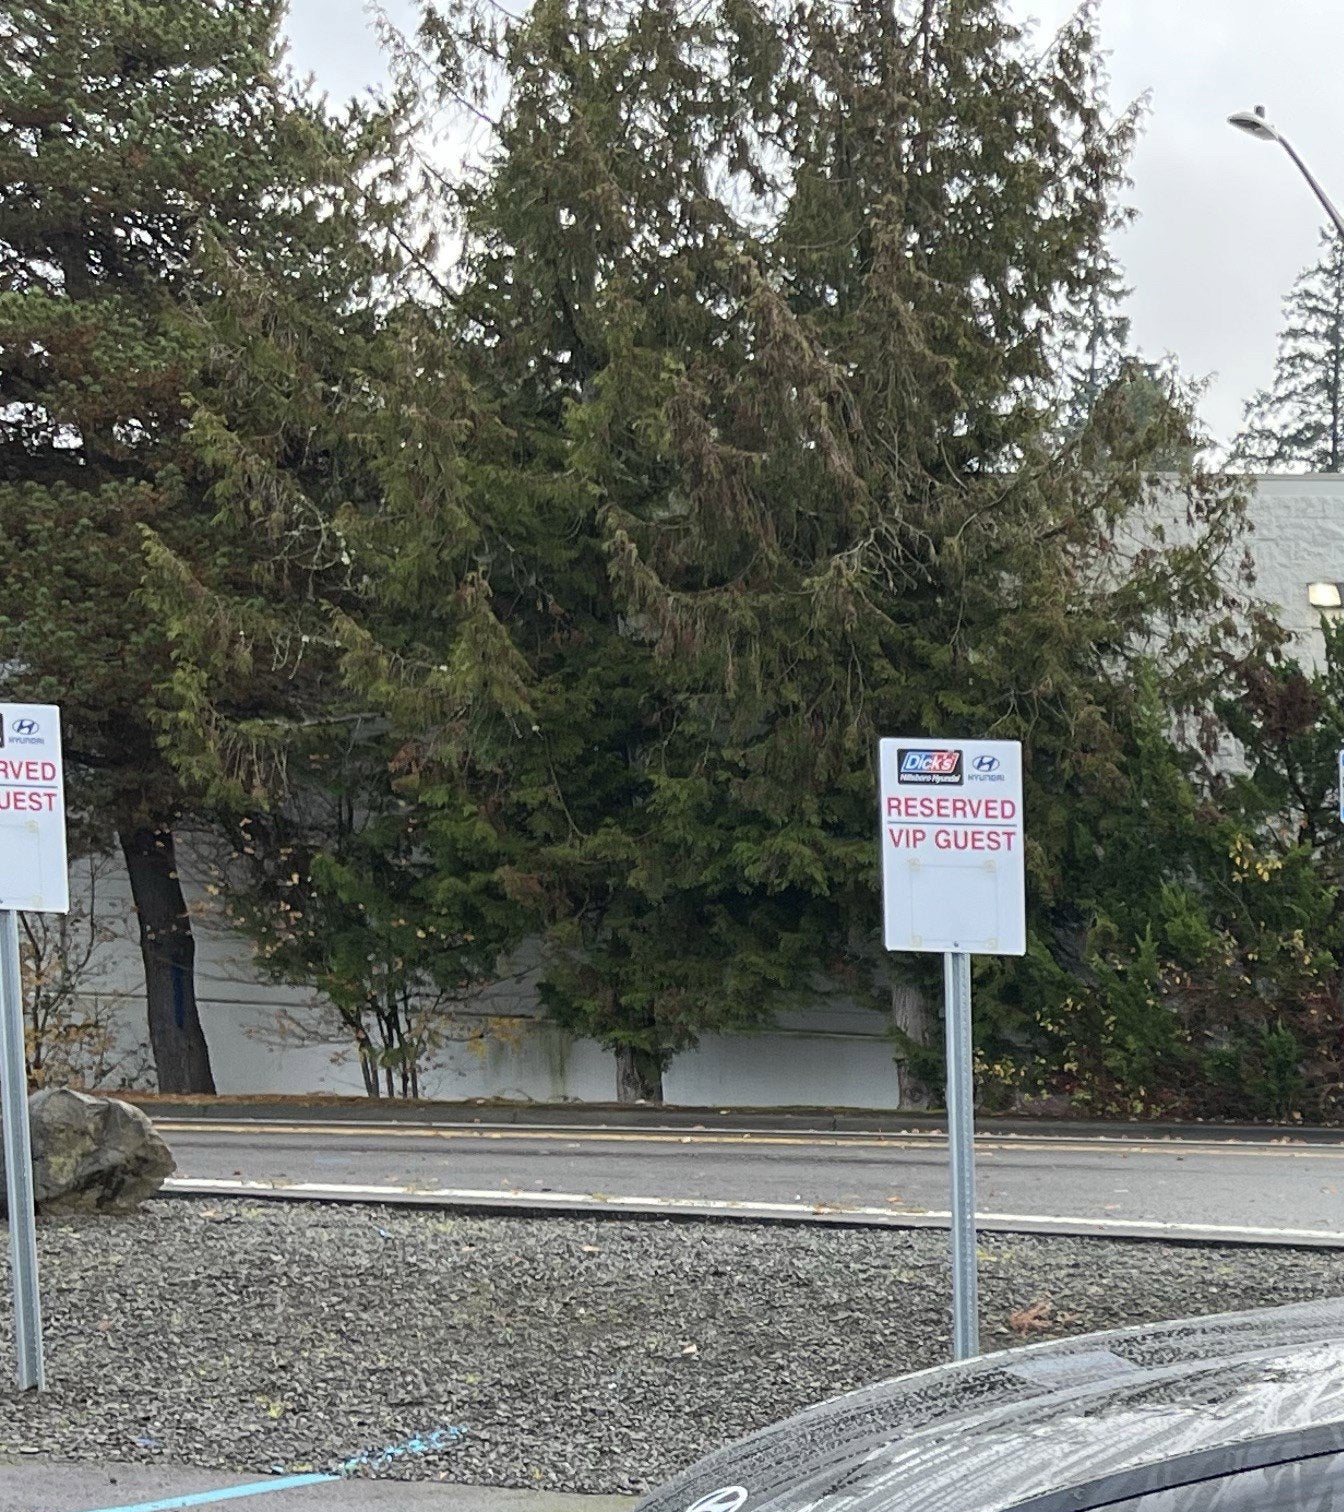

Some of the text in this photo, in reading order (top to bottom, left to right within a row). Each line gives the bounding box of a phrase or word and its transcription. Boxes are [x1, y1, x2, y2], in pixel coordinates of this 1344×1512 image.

[887, 797, 1016, 820] RESERVED
[889, 829, 1016, 851] VIP GUEST
